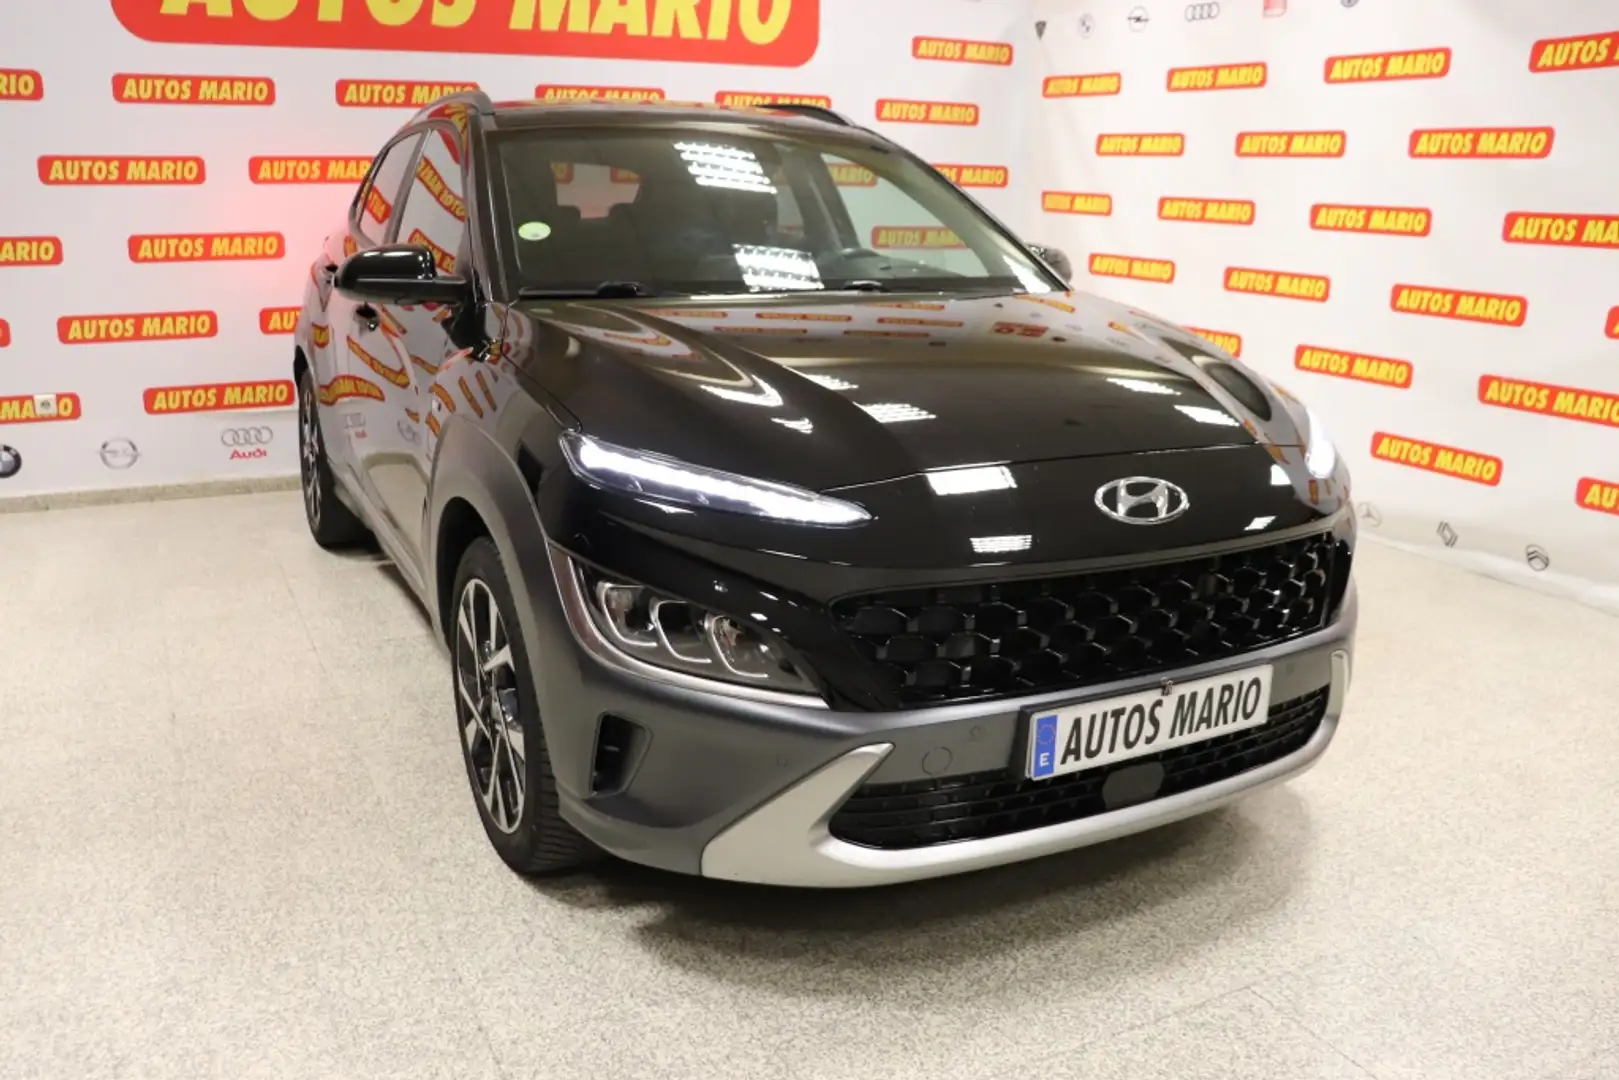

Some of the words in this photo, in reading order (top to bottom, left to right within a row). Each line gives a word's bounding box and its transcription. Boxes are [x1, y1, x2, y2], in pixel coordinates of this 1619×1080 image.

[918, 40, 960, 60] AUTOS
[964, 42, 1010, 63] MARIO
[1537, 37, 1612, 68] AUTOS
[1169, 68, 1214, 89] AUTOS
[1215, 65, 1264, 87] MARIO
[1329, 56, 1382, 80] AUTOS
[1385, 52, 1446, 77] MARIO
[123, 79, 191, 100] AUTOS
[198, 80, 269, 102] MARIO
[344, 83, 405, 104] AUTOS
[880, 102, 926, 121] AUTOS
[929, 103, 976, 123] MARIO
[1099, 136, 1139, 154] AUTOS
[1140, 135, 1183, 154] MARIO
[1239, 134, 1287, 155] AUTOS
[1289, 134, 1343, 154] MARIO
[1414, 131, 1474, 155] AUTOS
[1476, 131, 1548, 154] MARIO
[49, 160, 119, 181] AUTOS
[126, 160, 199, 181] MARIO
[258, 160, 321, 180] AUTOS
[960, 167, 1005, 185] MARIO
[1160, 200, 1203, 219] AUTOS
[1203, 203, 1252, 222] MARIO
[1315, 207, 1366, 229] AUTOS
[1368, 209, 1427, 233] MARIO
[1510, 217, 1578, 241] AUTOS
[137, 237, 205, 260] AUTOS
[210, 235, 278, 258] MARIO
[1092, 256, 1130, 275] AUTOS
[1131, 260, 1173, 280] MARIO
[1228, 271, 1273, 293] AUTOS
[1275, 275, 1327, 299] MARIO
[1396, 289, 1453, 314] AUTOS
[1455, 294, 1521, 321] MARIO
[68, 317, 136, 340] AUTOS
[141, 314, 211, 337] MARIO
[1299, 349, 1350, 373] AUTOS
[1351, 355, 1409, 384] MARIO
[153, 388, 217, 411] AUTOS
[223, 384, 289, 407] MARIO
[1485, 380, 1550, 409] AUTOS
[229, 448, 267, 460] Audi
[1376, 437, 1432, 465] AUTOS
[1434, 451, 1497, 481] MARIO
[1060, 698, 1164, 765] AUTOS
[1169, 676, 1262, 739] MARIO
[1039, 752, 1050, 767] E
